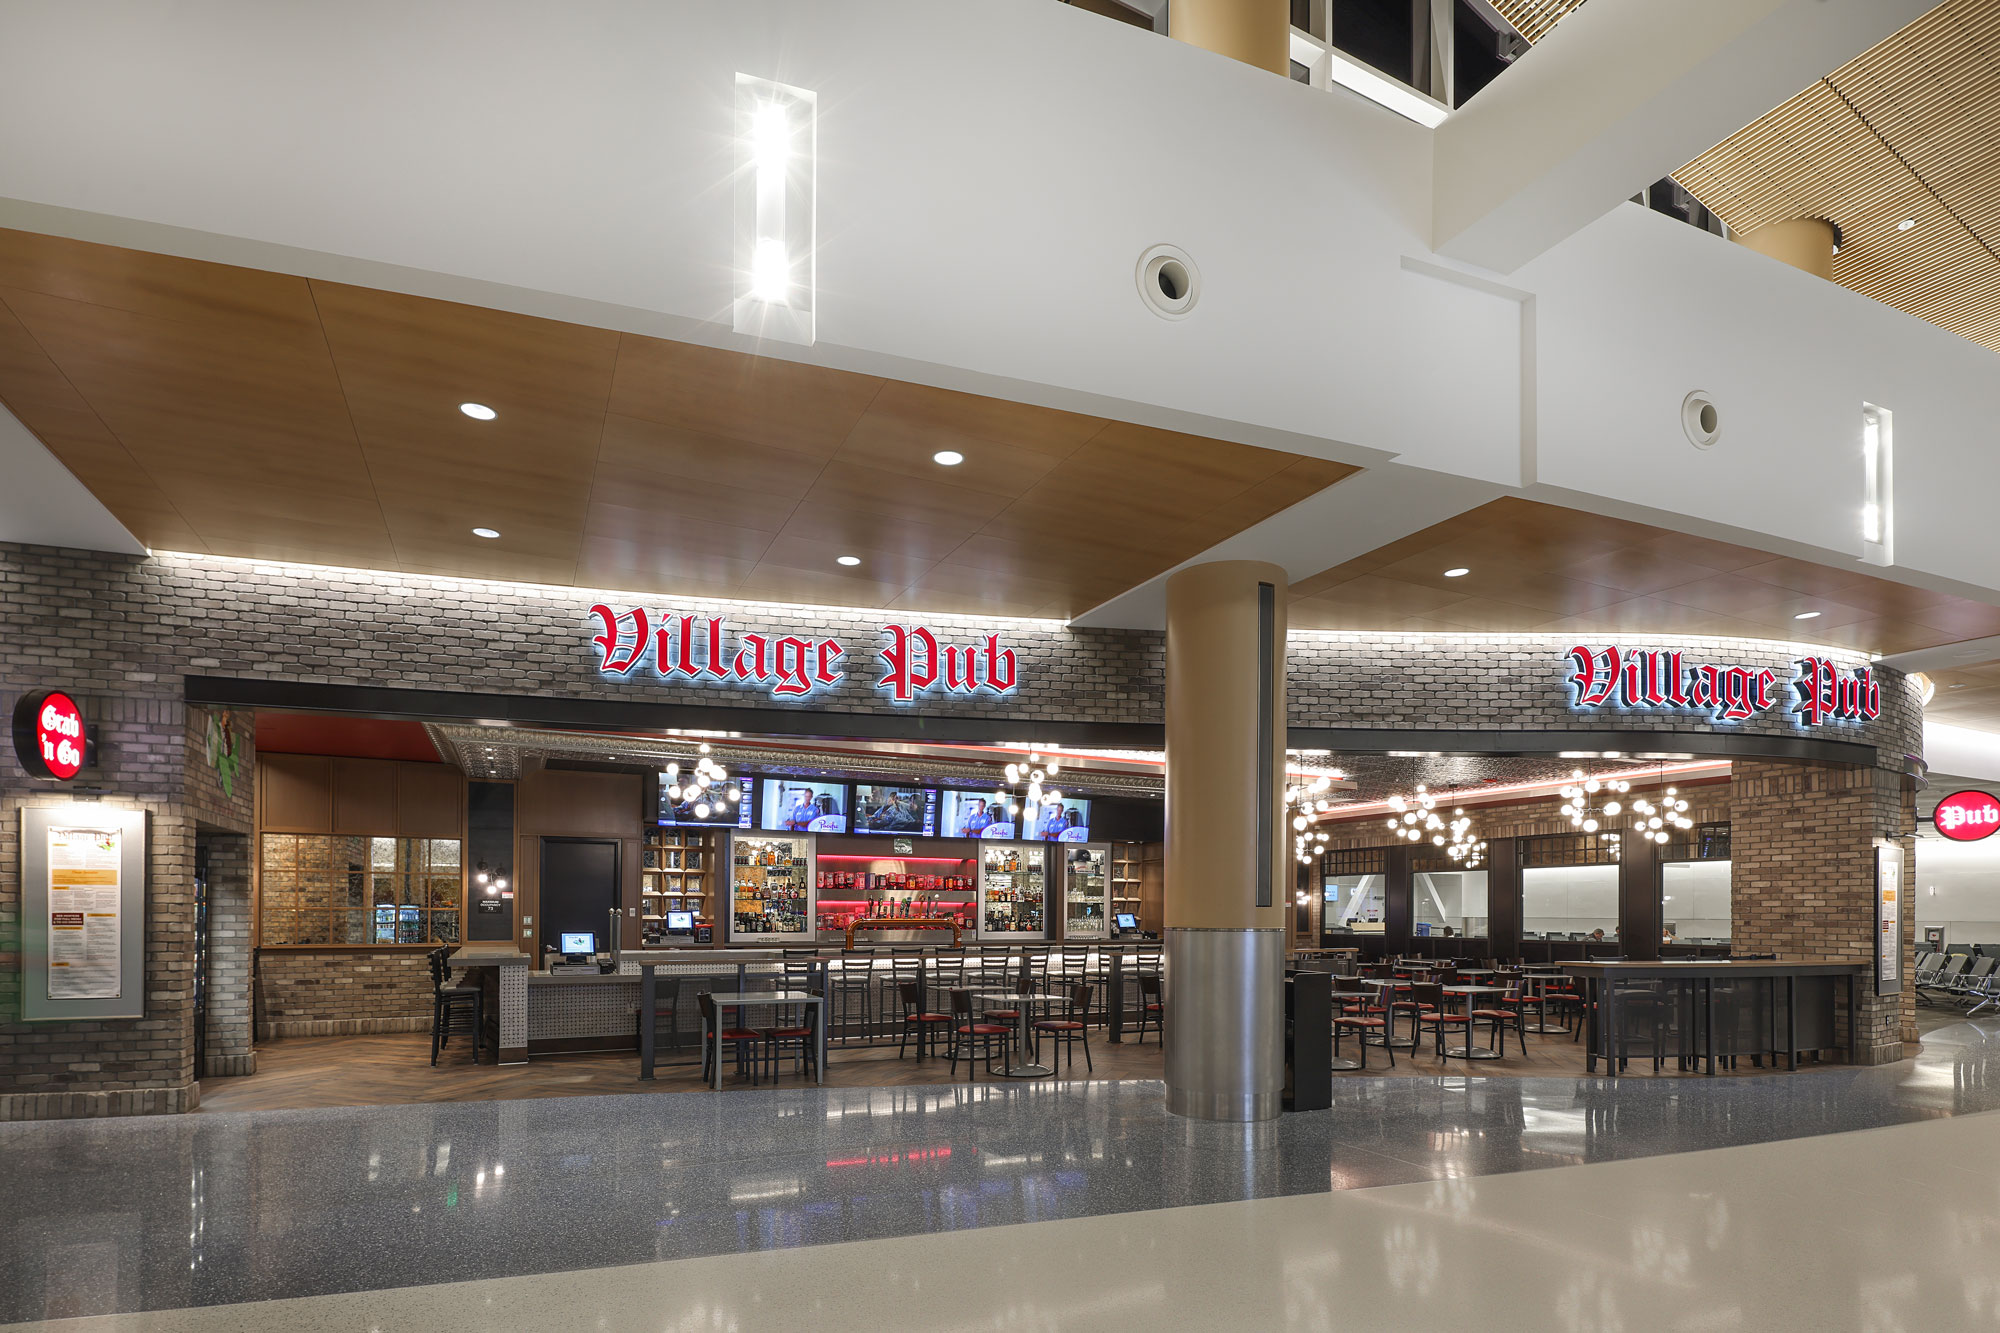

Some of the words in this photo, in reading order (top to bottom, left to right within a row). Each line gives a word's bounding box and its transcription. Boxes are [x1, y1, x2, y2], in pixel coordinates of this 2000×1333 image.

[588, 603, 845, 696] Village
[877, 623, 1018, 702] Pub
[1567, 645, 1777, 721] Village
[1794, 656, 1881, 726] Pub
[41, 704, 79, 738] Grab
[57, 739, 80, 767] Go
[1940, 804, 1999, 830] Pub
